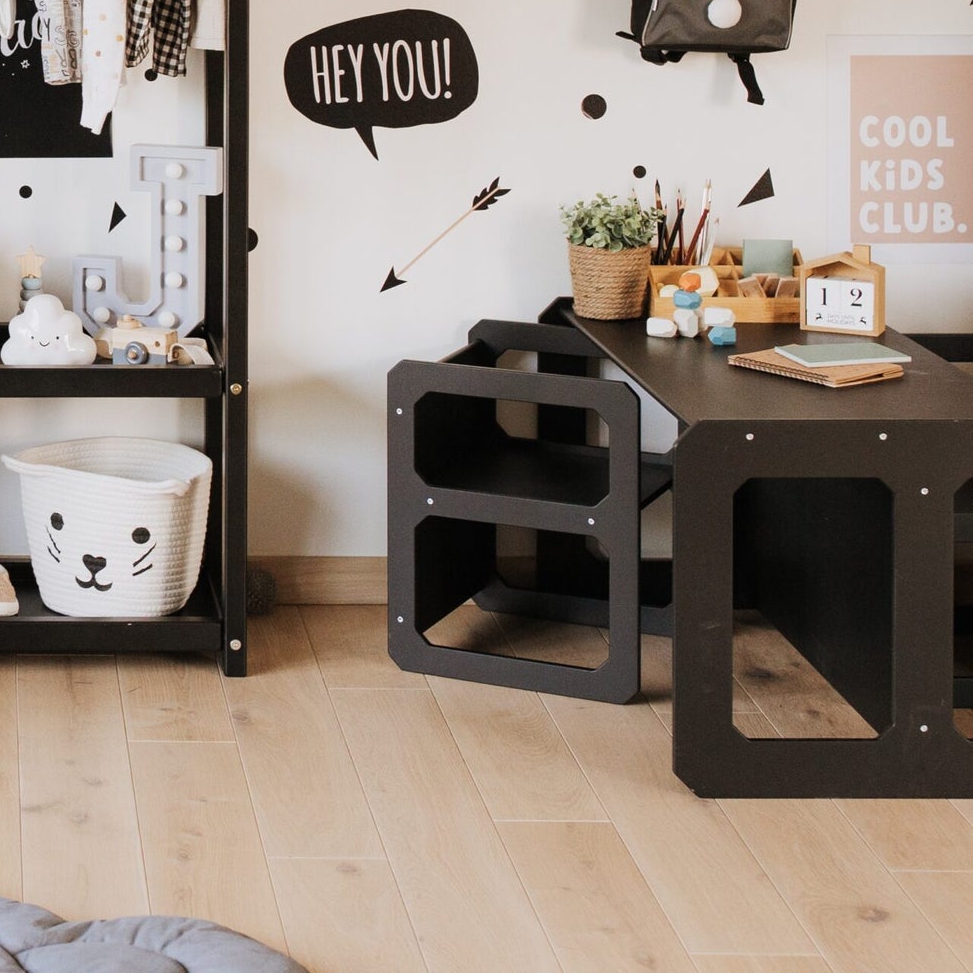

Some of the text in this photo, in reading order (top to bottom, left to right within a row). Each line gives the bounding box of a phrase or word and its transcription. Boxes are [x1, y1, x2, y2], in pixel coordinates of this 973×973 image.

[310, 37, 452, 104] HEY YOU!
[859, 115, 954, 148] COOL
[859, 201, 968, 235] CLUB.
[821, 287, 863, 307] 1 2
